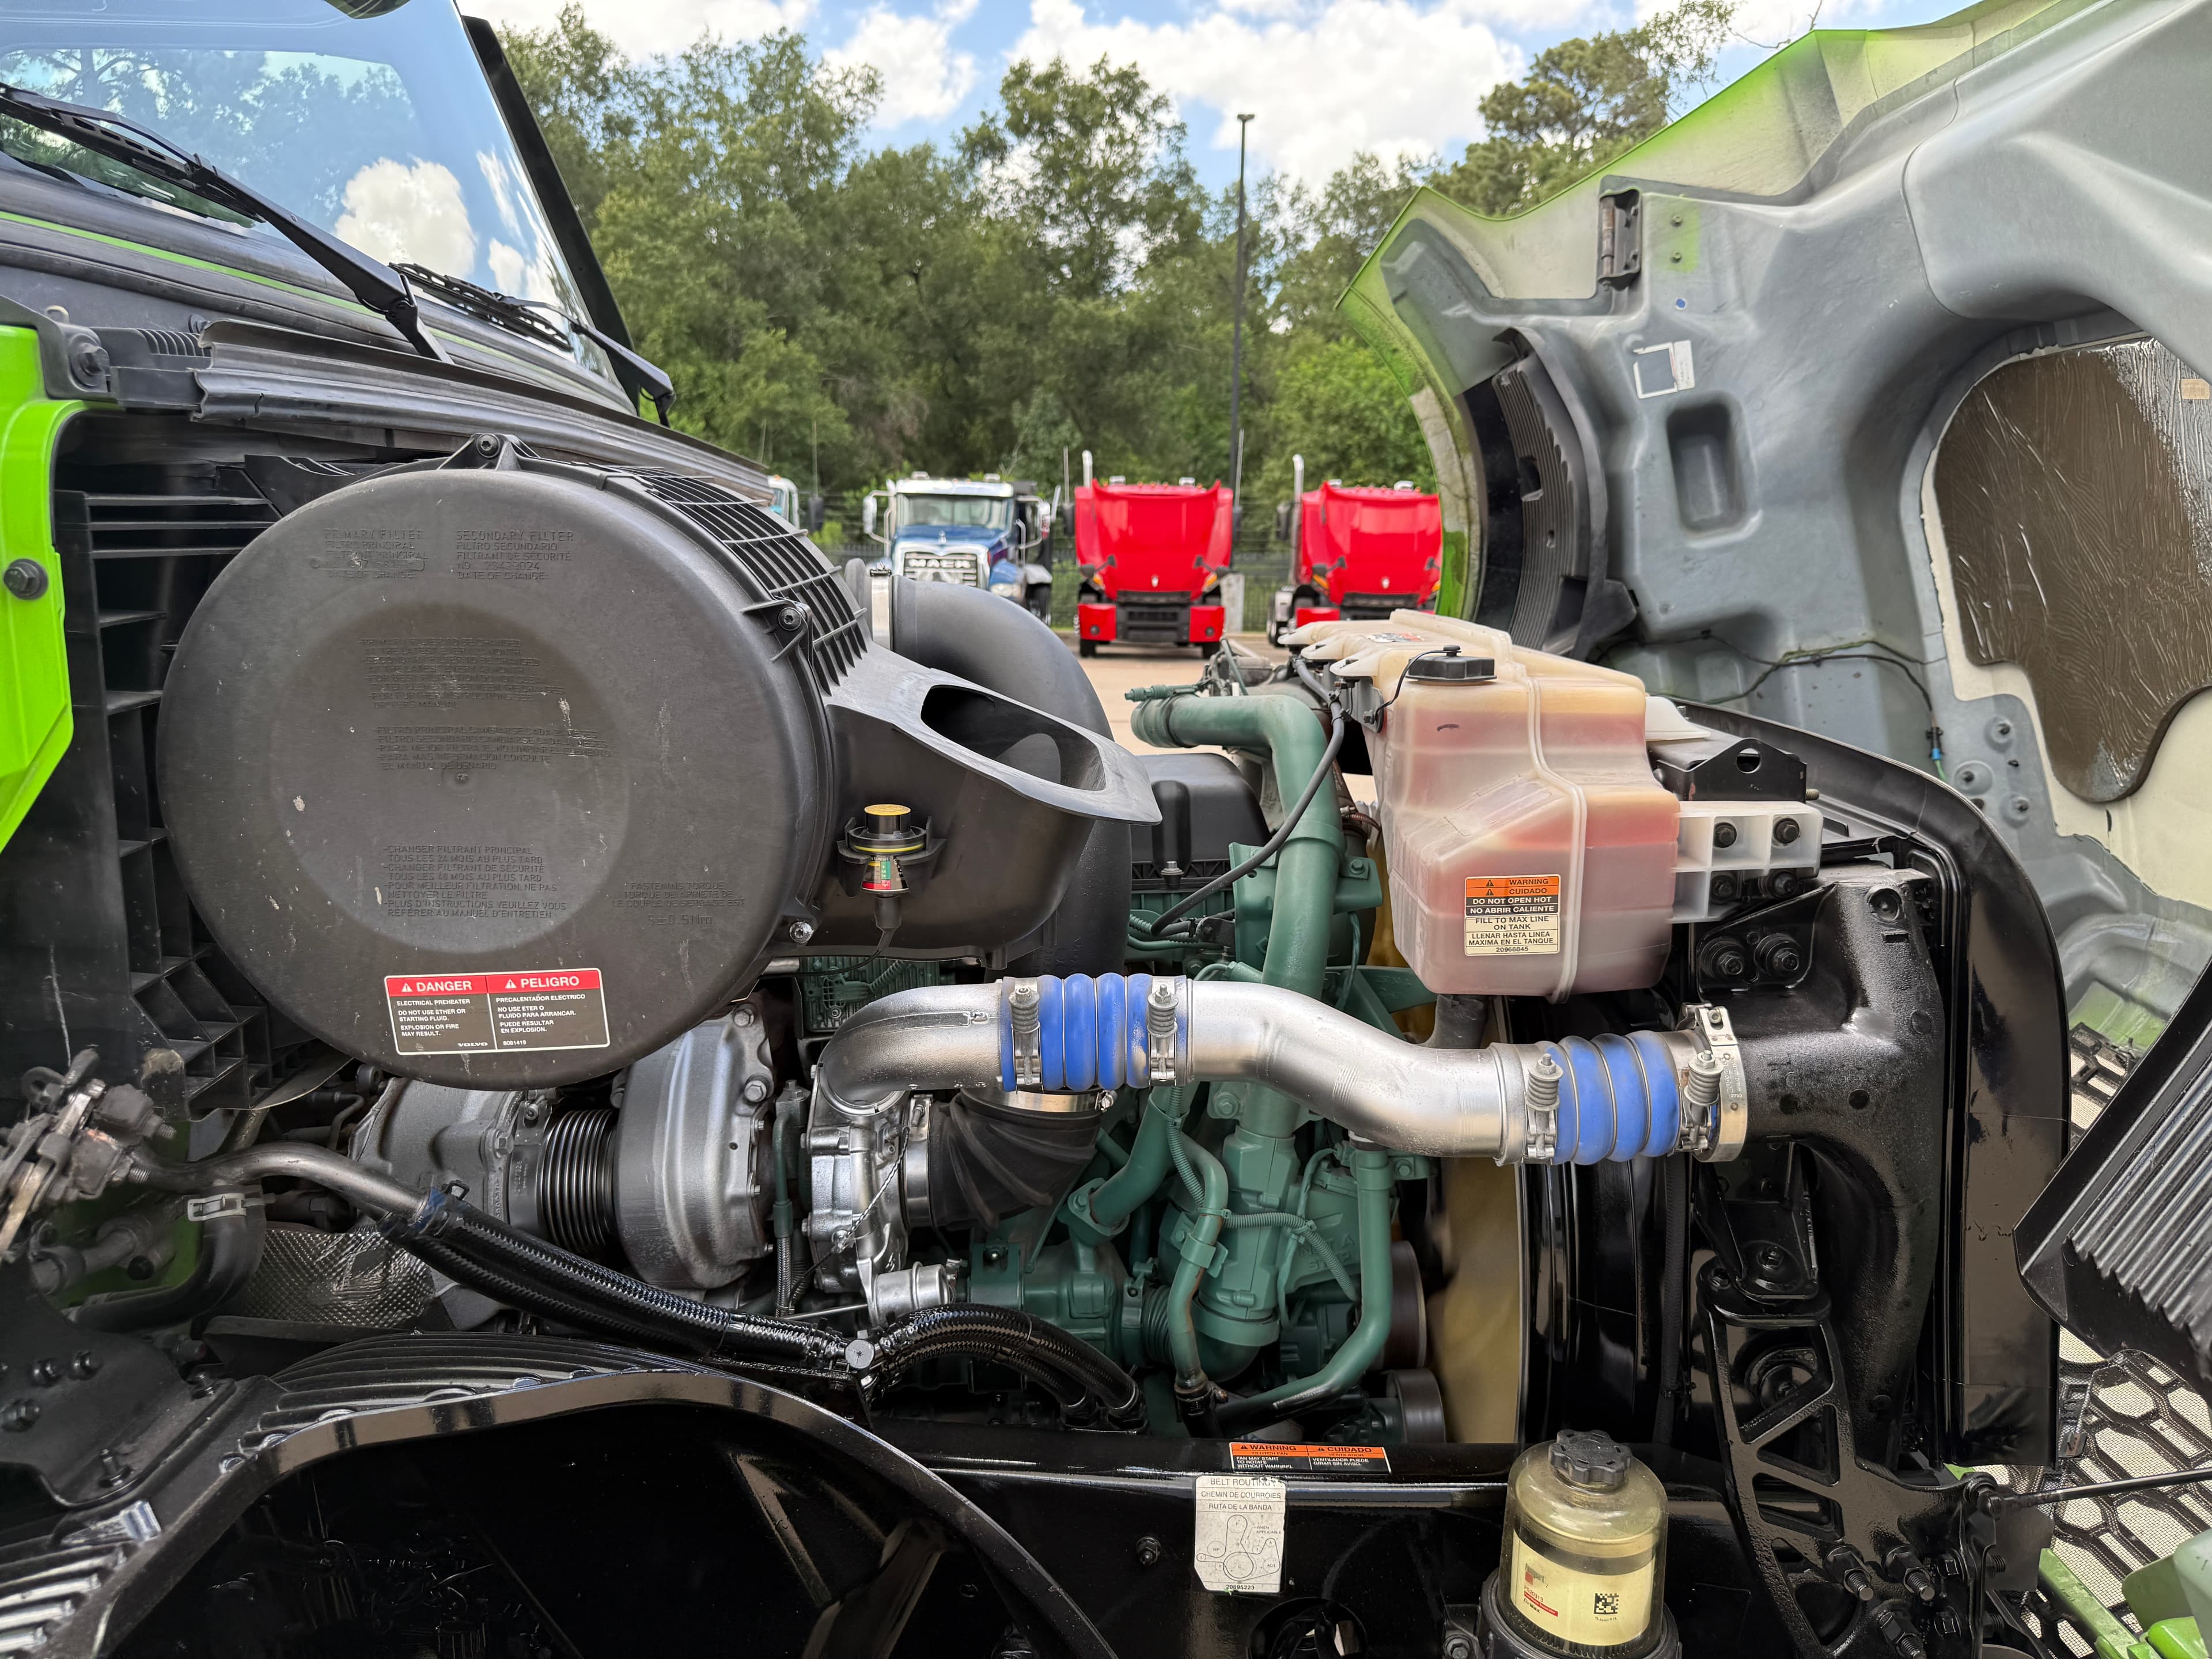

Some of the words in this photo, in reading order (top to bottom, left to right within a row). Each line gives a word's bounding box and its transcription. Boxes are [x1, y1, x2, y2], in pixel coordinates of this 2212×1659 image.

[381, 529, 424, 540] FILTER
[456, 531, 524, 541] SECONDARY
[530, 531, 574, 541] FILTER
[457, 542, 490, 550] FILTRO
[494, 543, 558, 551] SECUNDARIO
[909, 559, 971, 568] MACK
[485, 846, 533, 854] PRINCIPAL
[687, 881, 724, 889] TORQUE
[388, 891, 438, 899] NETTOYER
[456, 891, 488, 899] FILTRE
[416, 900, 493, 908] D'INSTRUCTIONS
[499, 901, 539, 909] VEUILLEZ
[728, 899, 745, 907] EST
[493, 910, 551, 918] D'ENTRETIEN
[416, 980, 472, 992] DANGER
[521, 976, 579, 988] PELIGRO
[1309, 1250, 1351, 1271] SP
